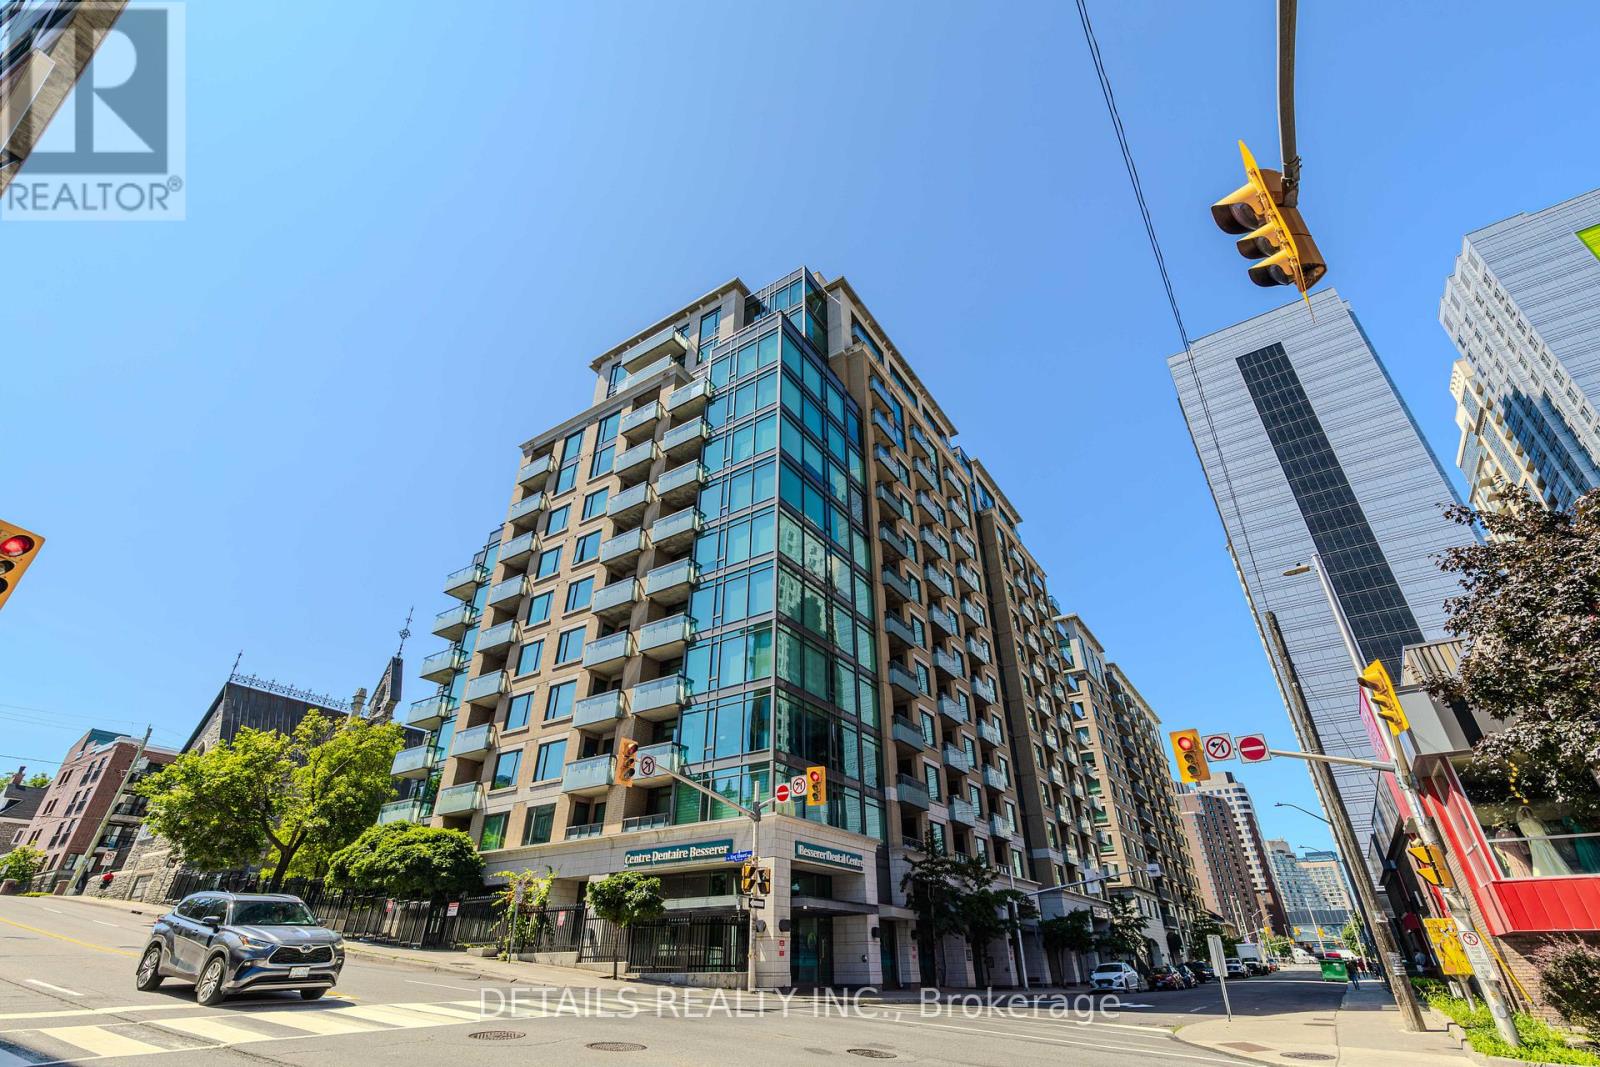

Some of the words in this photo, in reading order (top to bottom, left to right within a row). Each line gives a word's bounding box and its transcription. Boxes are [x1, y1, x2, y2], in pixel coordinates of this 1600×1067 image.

[625, 852, 651, 865] Centre
[652, 847, 689, 862] Dentaire
[690, 844, 729, 858] Besserer
[799, 844, 826, 860] Besserer
[826, 850, 846, 864] Dental
[846, 855, 864, 867] Centre
